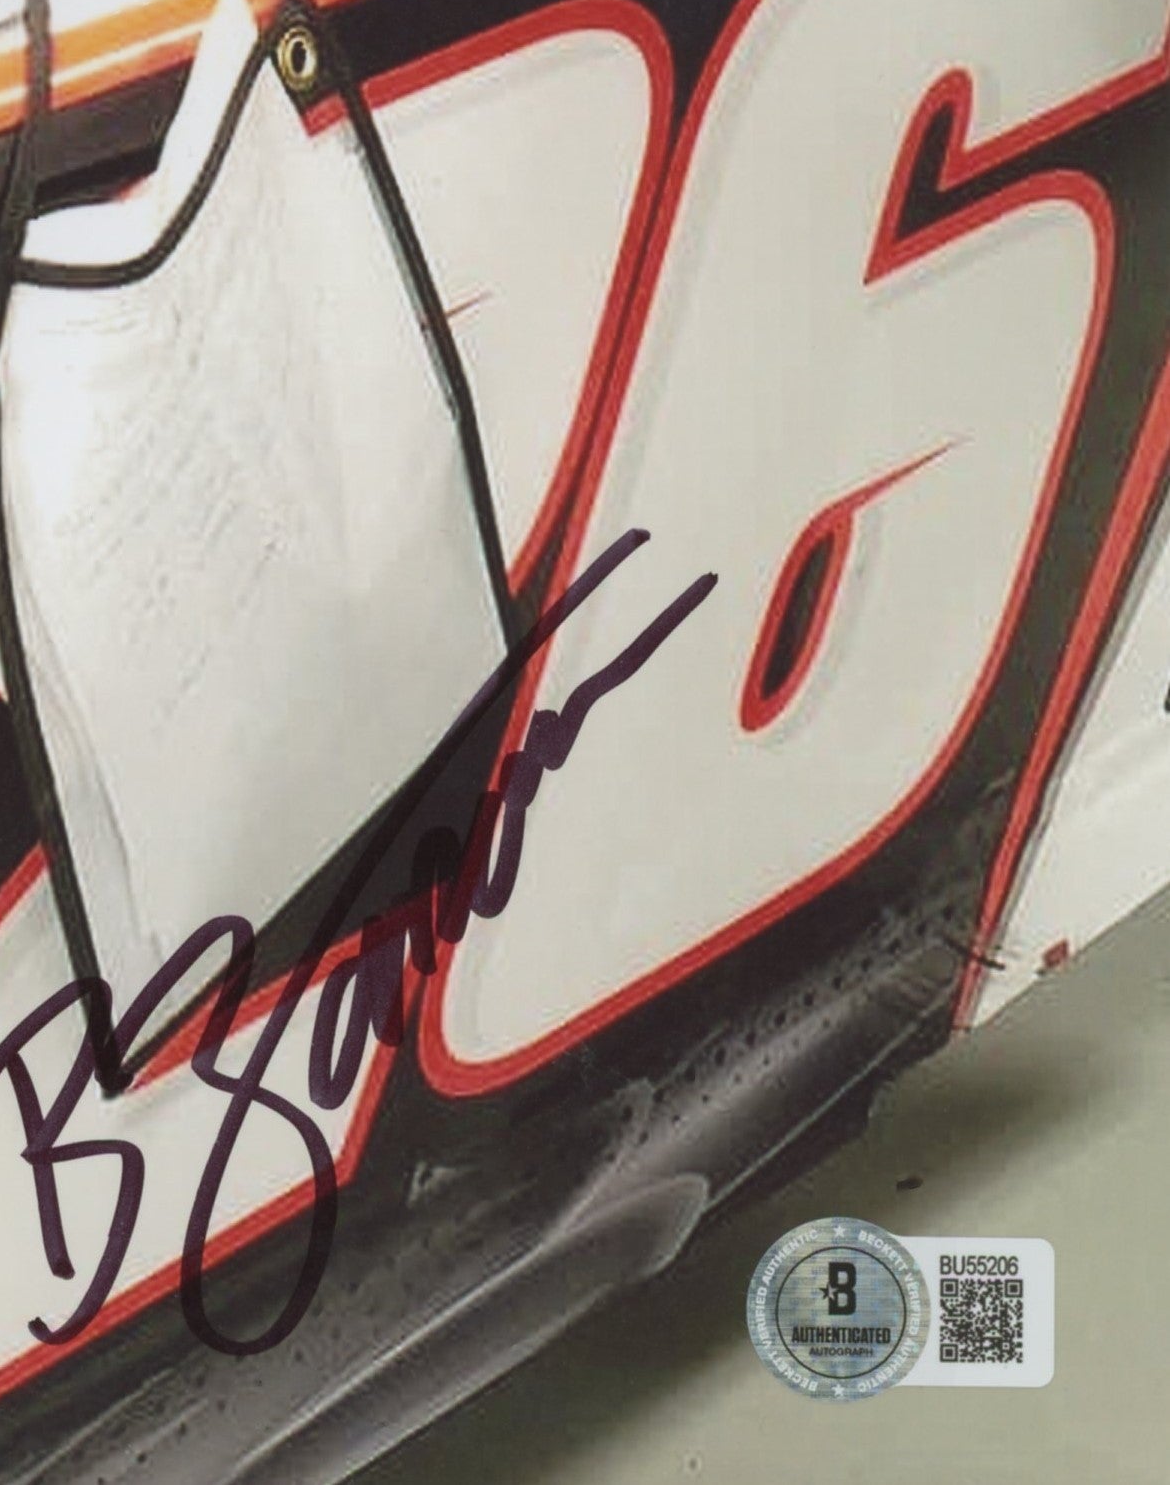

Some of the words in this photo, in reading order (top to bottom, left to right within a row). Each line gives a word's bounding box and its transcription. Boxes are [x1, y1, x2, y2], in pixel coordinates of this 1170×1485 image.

[761, 1228, 820, 1286] AUTHENTIC
[857, 1229, 909, 1272] BECKETT
[939, 1254, 1019, 1276] BU55206
[754, 1286, 772, 1348] VERIFIED
[904, 1272, 922, 1335] VERIFIED
[791, 1325, 892, 1344] AUTHENTICATED
[808, 1345, 875, 1358] AUTOGRAPH
[767, 1350, 819, 1393] BECKETT
[856, 1336, 916, 1393] AUTHENTIC
